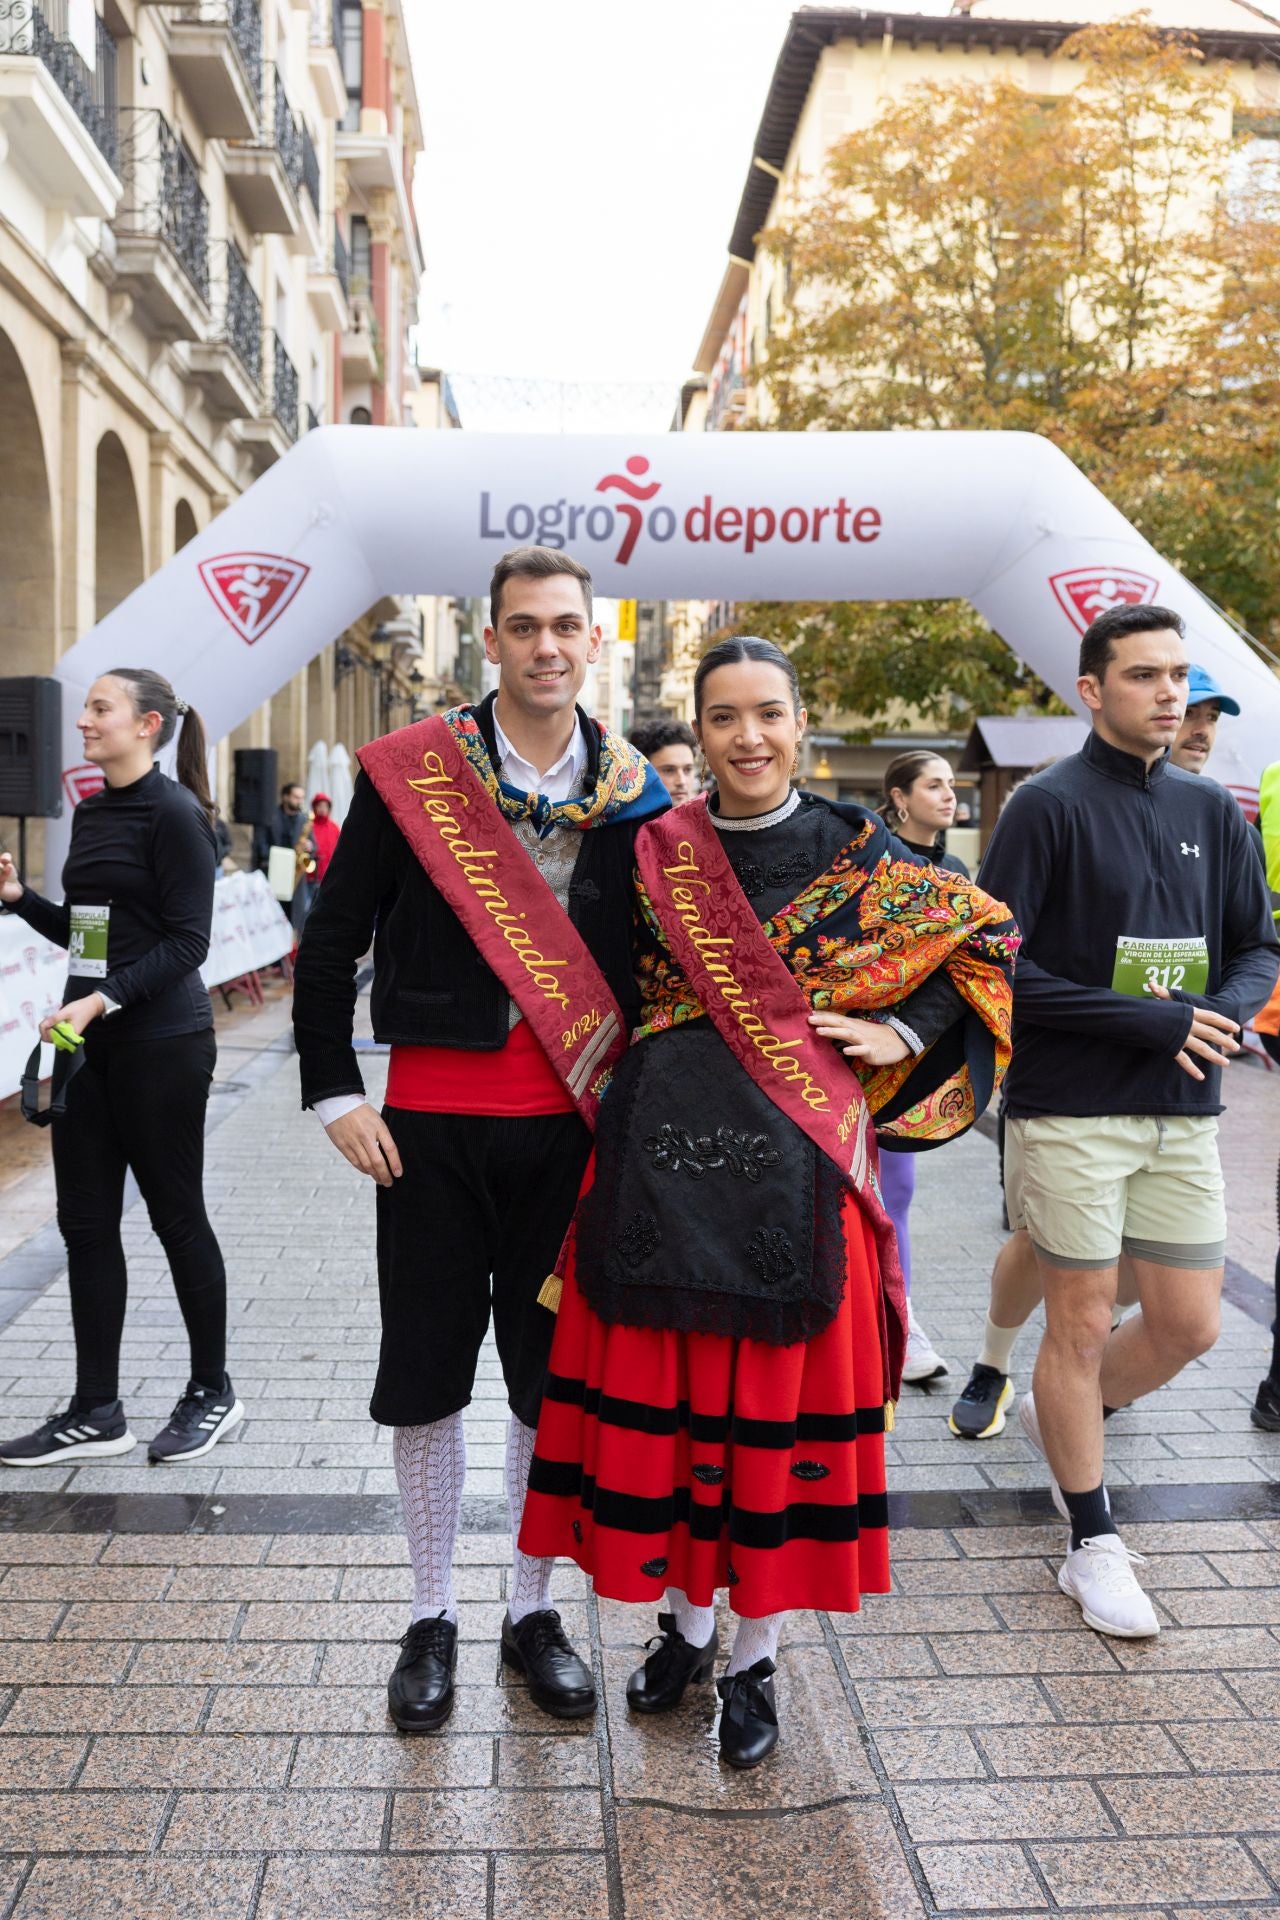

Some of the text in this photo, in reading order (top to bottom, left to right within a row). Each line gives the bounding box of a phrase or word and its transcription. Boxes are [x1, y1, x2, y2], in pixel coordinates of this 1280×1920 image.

[684, 495, 882, 553] deporte
[407, 751, 570, 1011] Vendimiador
[1122, 941, 1169, 950] CARRERA
[1124, 950, 1152, 958] VIRGEN
[663, 840, 831, 1113] Vendimiadora
[1142, 965, 1185, 993] 312
[561, 1008, 602, 1052] 2024
[837, 1097, 860, 1144] 2024
